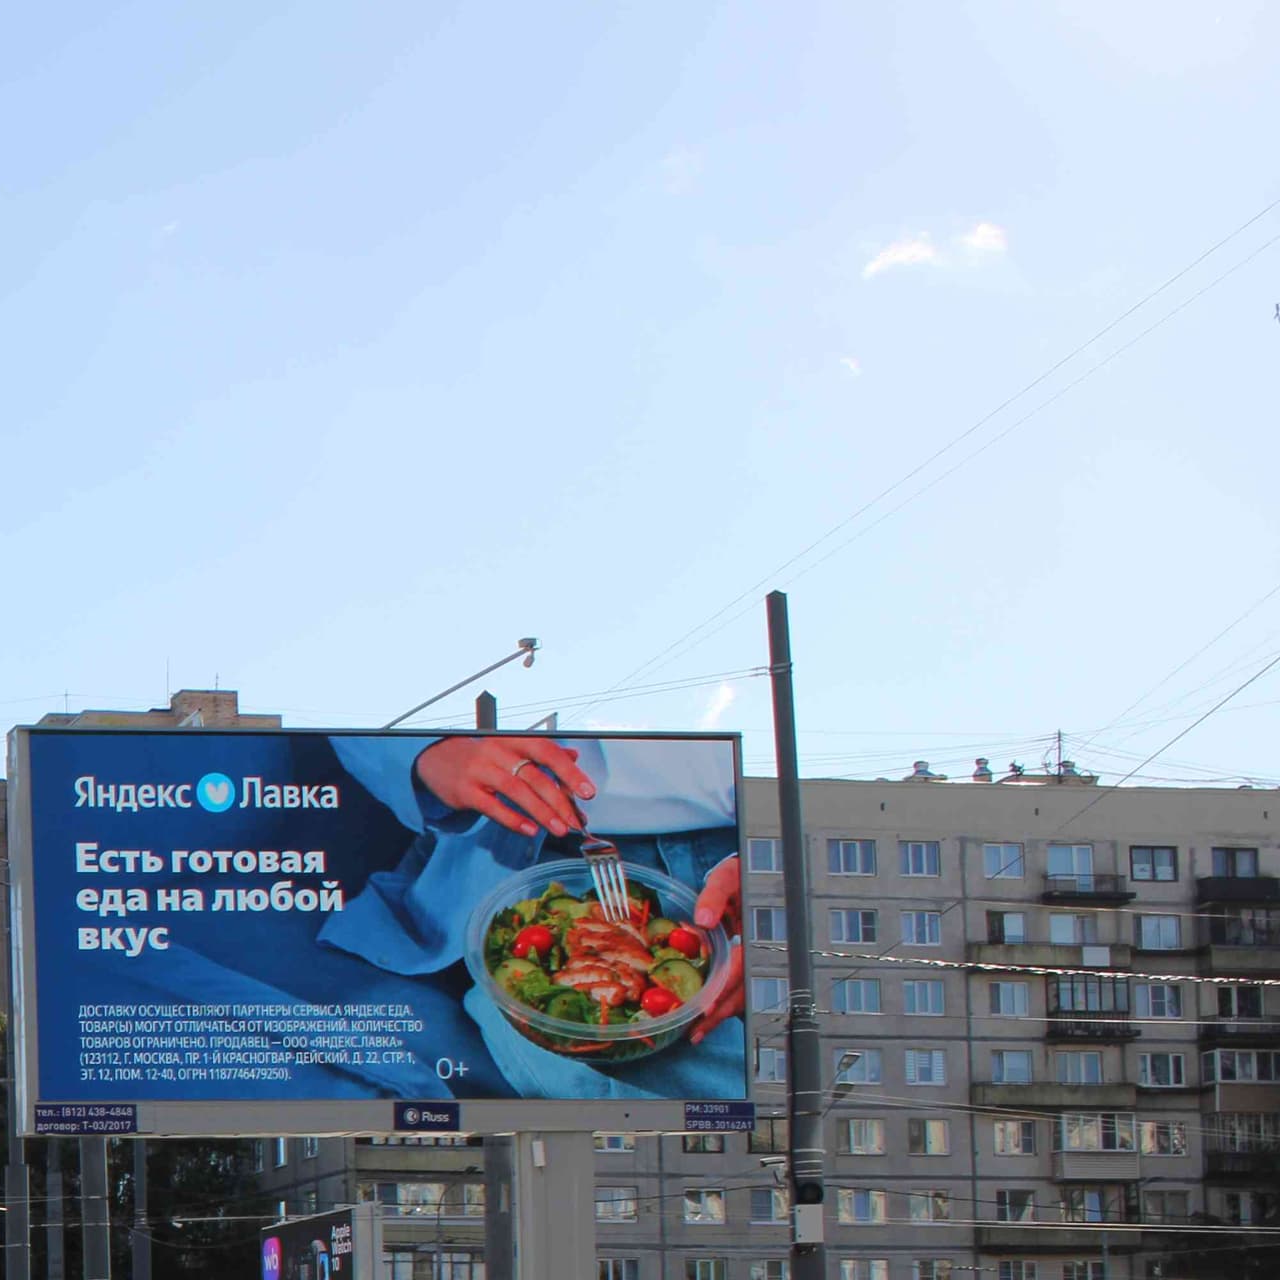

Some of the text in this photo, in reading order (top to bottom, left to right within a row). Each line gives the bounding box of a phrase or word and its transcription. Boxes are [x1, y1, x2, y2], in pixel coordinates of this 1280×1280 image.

[74, 776, 338, 812] Яндекс Лавка
[75, 842, 325, 873] Есть готовая
[76, 880, 343, 917] еда на любой
[77, 926, 169, 957] вкус
[78, 1005, 414, 1018] ДОСТАВКУ ОСУЩЕСТВЛЯЮТ ПАРТНЕРЫ СЕРВИСА ЯНДЕКС ЕДА.
[79, 1018, 423, 1033] ТОВАР(Ы) МОГУТ ОТЛИЧАТЬСЯ ОТ ИЗОБРАЖЕНИЙ. КОЛИЧЕСТВО
[80, 1037, 131, 1048] ТОВАРОВ
[133, 1037, 208, 1049] ОГРАНИЧЕНО.
[210, 1036, 269, 1050] ПРОДАВЕЦ
[283, 1036, 307, 1048] ООО
[79, 1053, 122, 1066] (123112,
[134, 1053, 183, 1066] МОСКВА,
[115, 1069, 143, 1080] ПОМ.
[178, 1069, 207, 1079] ОГРН
[436, 1057, 469, 1080] 0+
[421, 1111, 450, 1122] Russ
[331, 1224, 351, 1241] Apple
[331, 1240, 352, 1256] Watch
[263, 1248, 279, 1271] wb
[331, 1256, 340, 1272] 10
